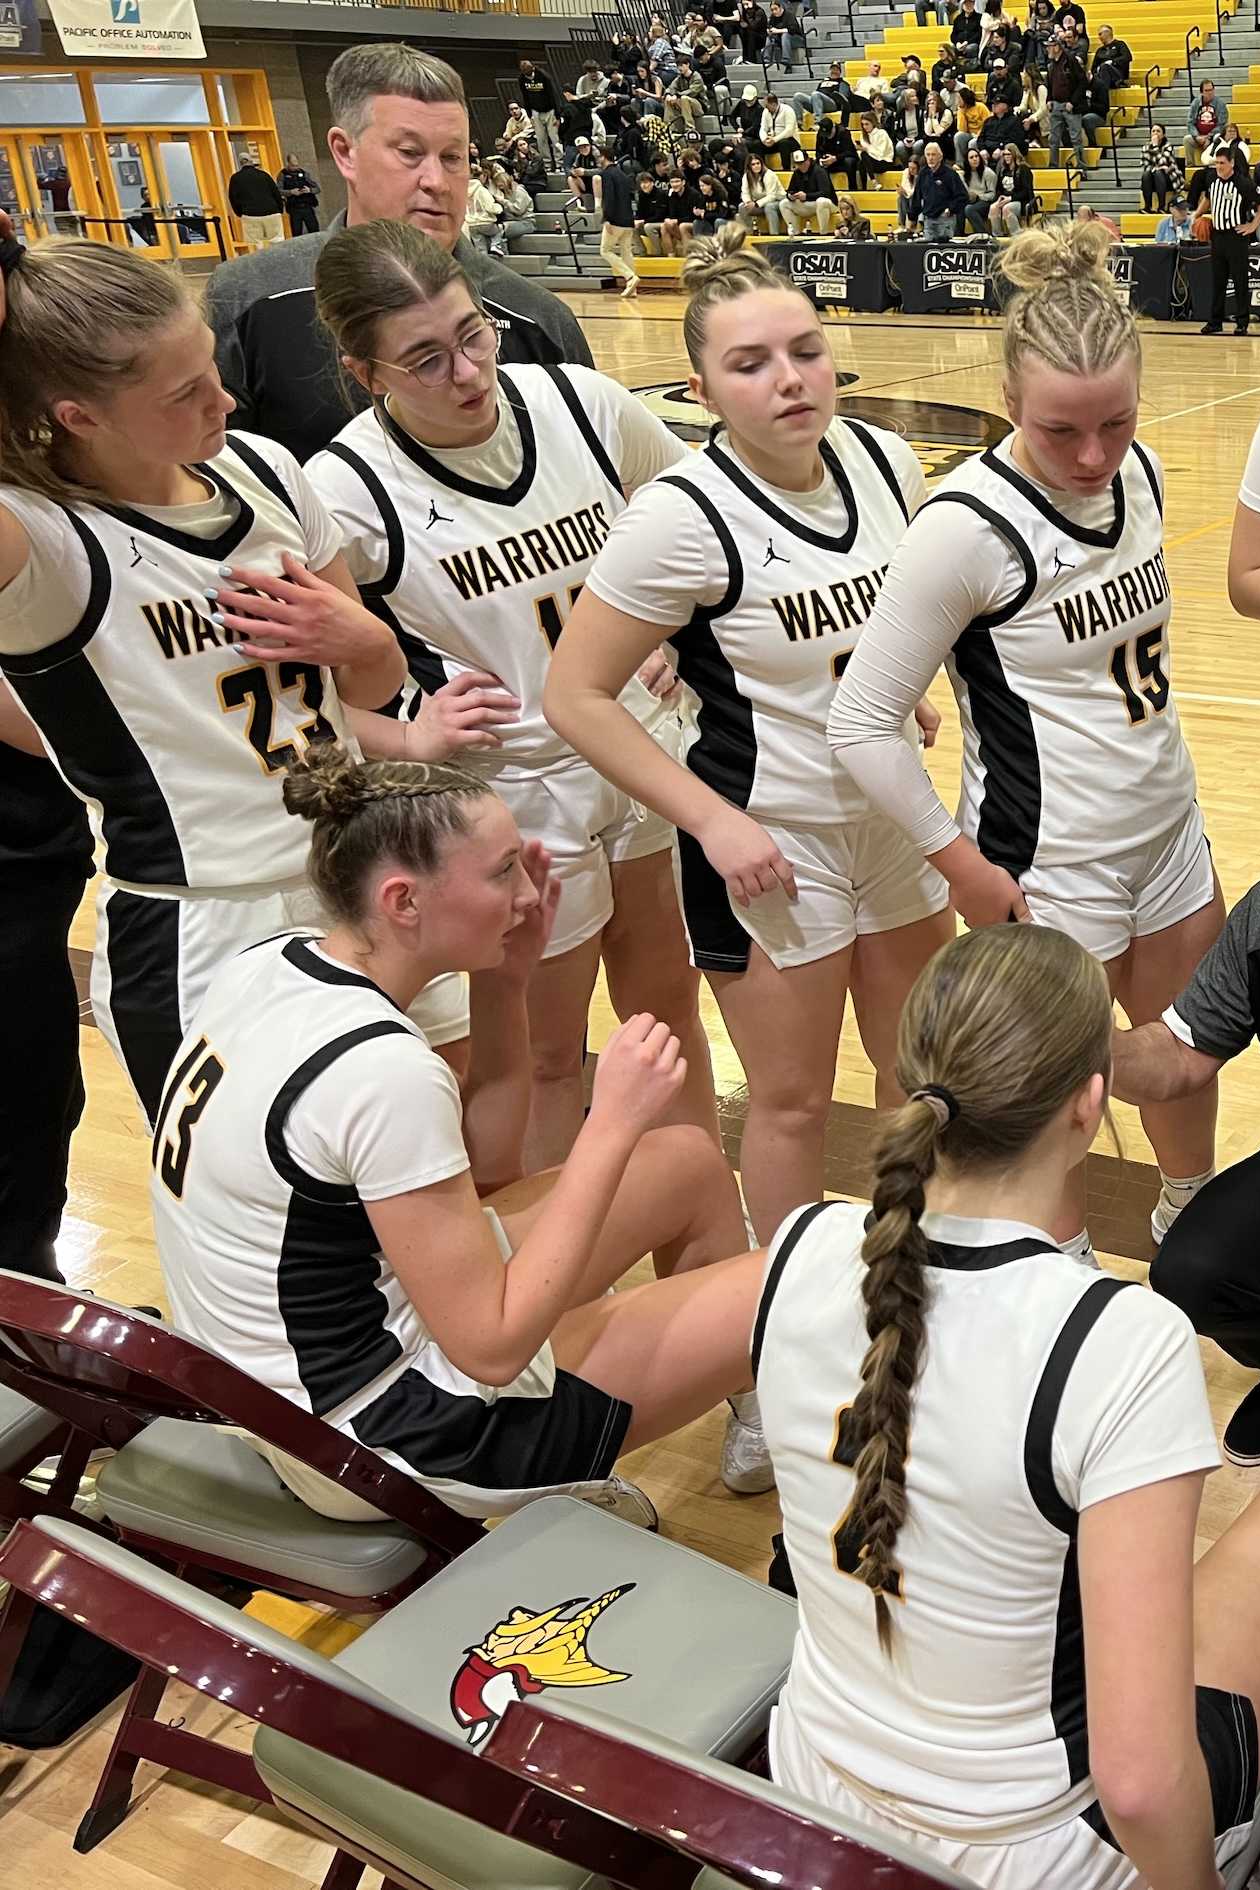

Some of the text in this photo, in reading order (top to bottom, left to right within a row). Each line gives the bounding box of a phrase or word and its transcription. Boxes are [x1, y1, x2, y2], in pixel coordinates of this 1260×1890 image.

[63, 27, 192, 40] PACIFIC OFFICE AUTOMATION
[791, 253, 847, 276] OSAA
[926, 249, 985, 276] OSAA
[438, 501, 612, 600] WARRIORS
[1108, 619, 1171, 727] 15
